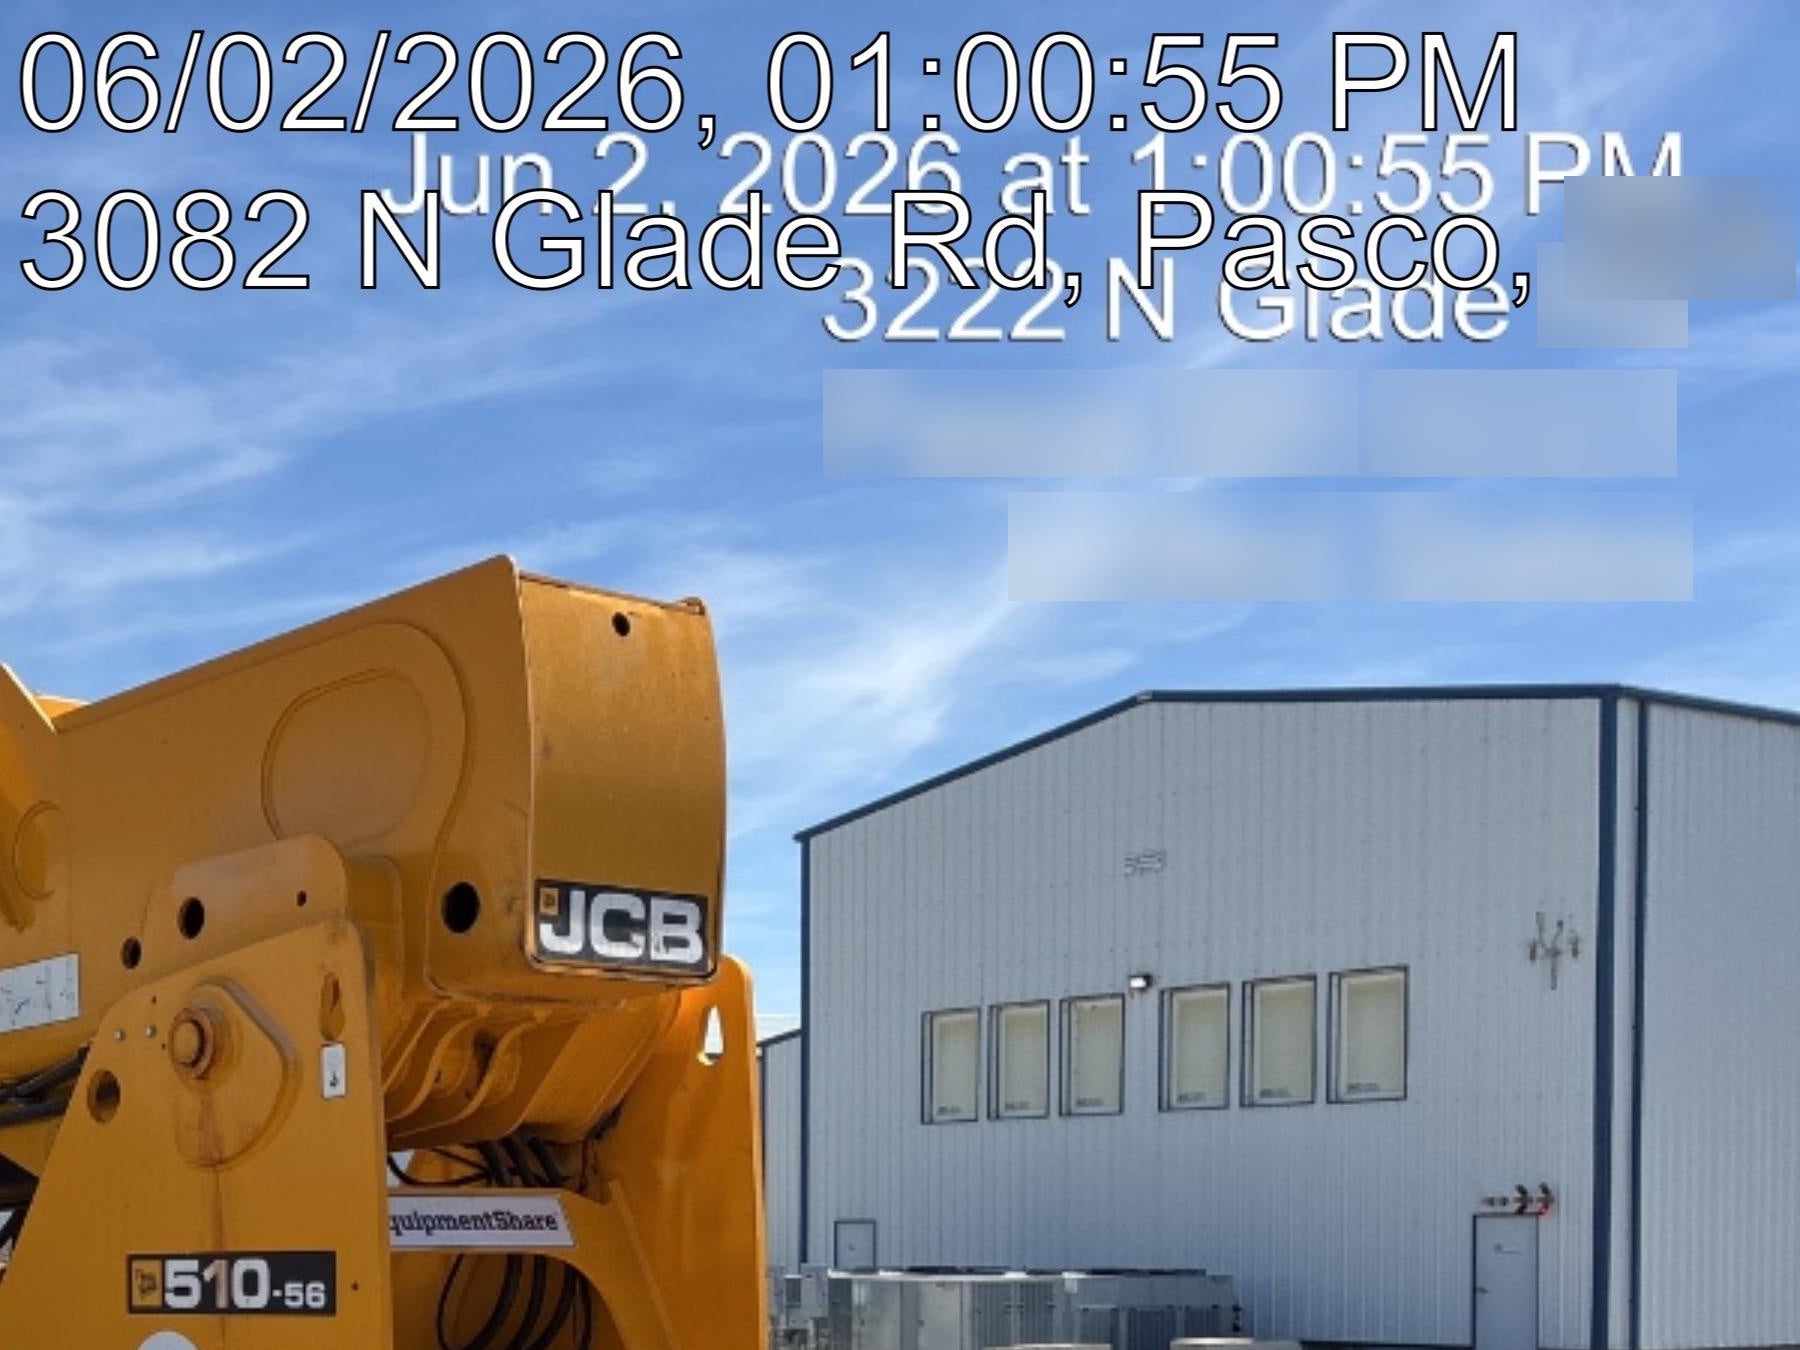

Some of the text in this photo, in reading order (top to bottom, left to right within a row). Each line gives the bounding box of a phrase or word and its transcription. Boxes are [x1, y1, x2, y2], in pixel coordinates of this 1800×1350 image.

[539, 889, 704, 965] JCB
[388, 1208, 559, 1237] quipmentShare
[163, 1257, 326, 1309] 510-56
